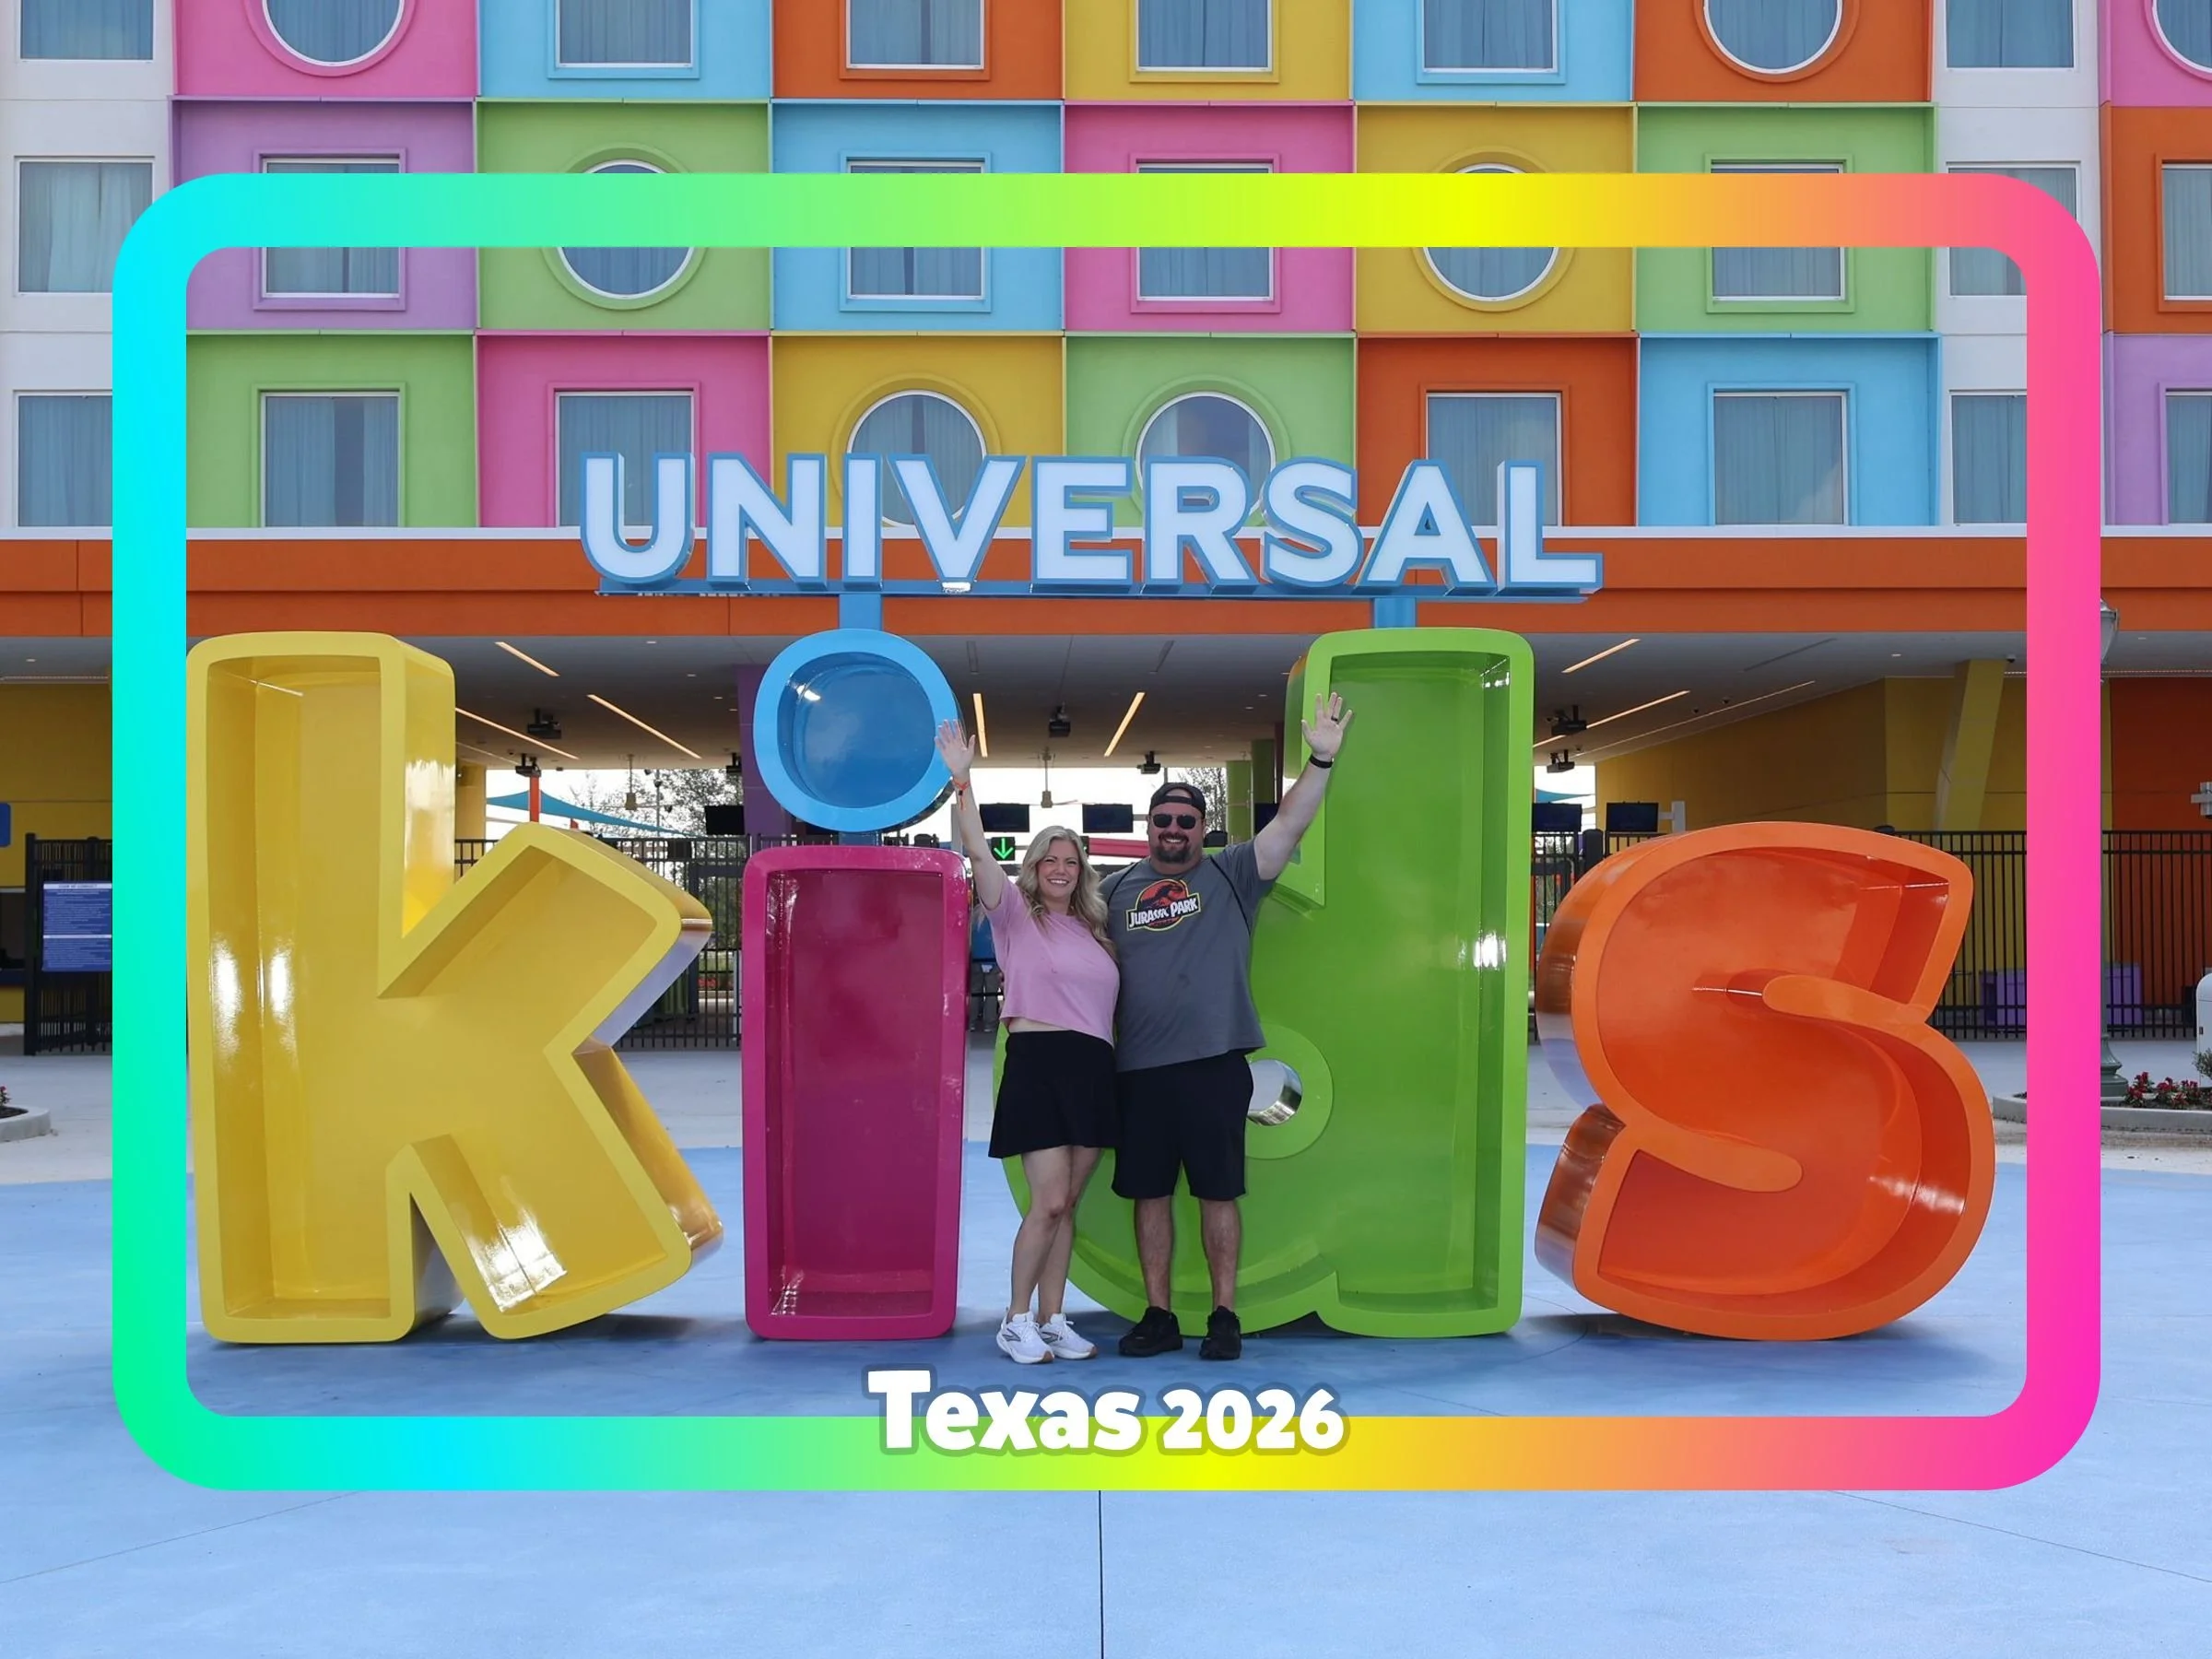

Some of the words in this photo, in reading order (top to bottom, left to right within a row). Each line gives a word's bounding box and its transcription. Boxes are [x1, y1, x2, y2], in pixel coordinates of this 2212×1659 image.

[580, 452, 1604, 594] UNIVERSAL
[1129, 906, 1170, 928] JURASSIC
[1170, 898, 1198, 918] PARK
[186, 629, 1995, 1344] kids
